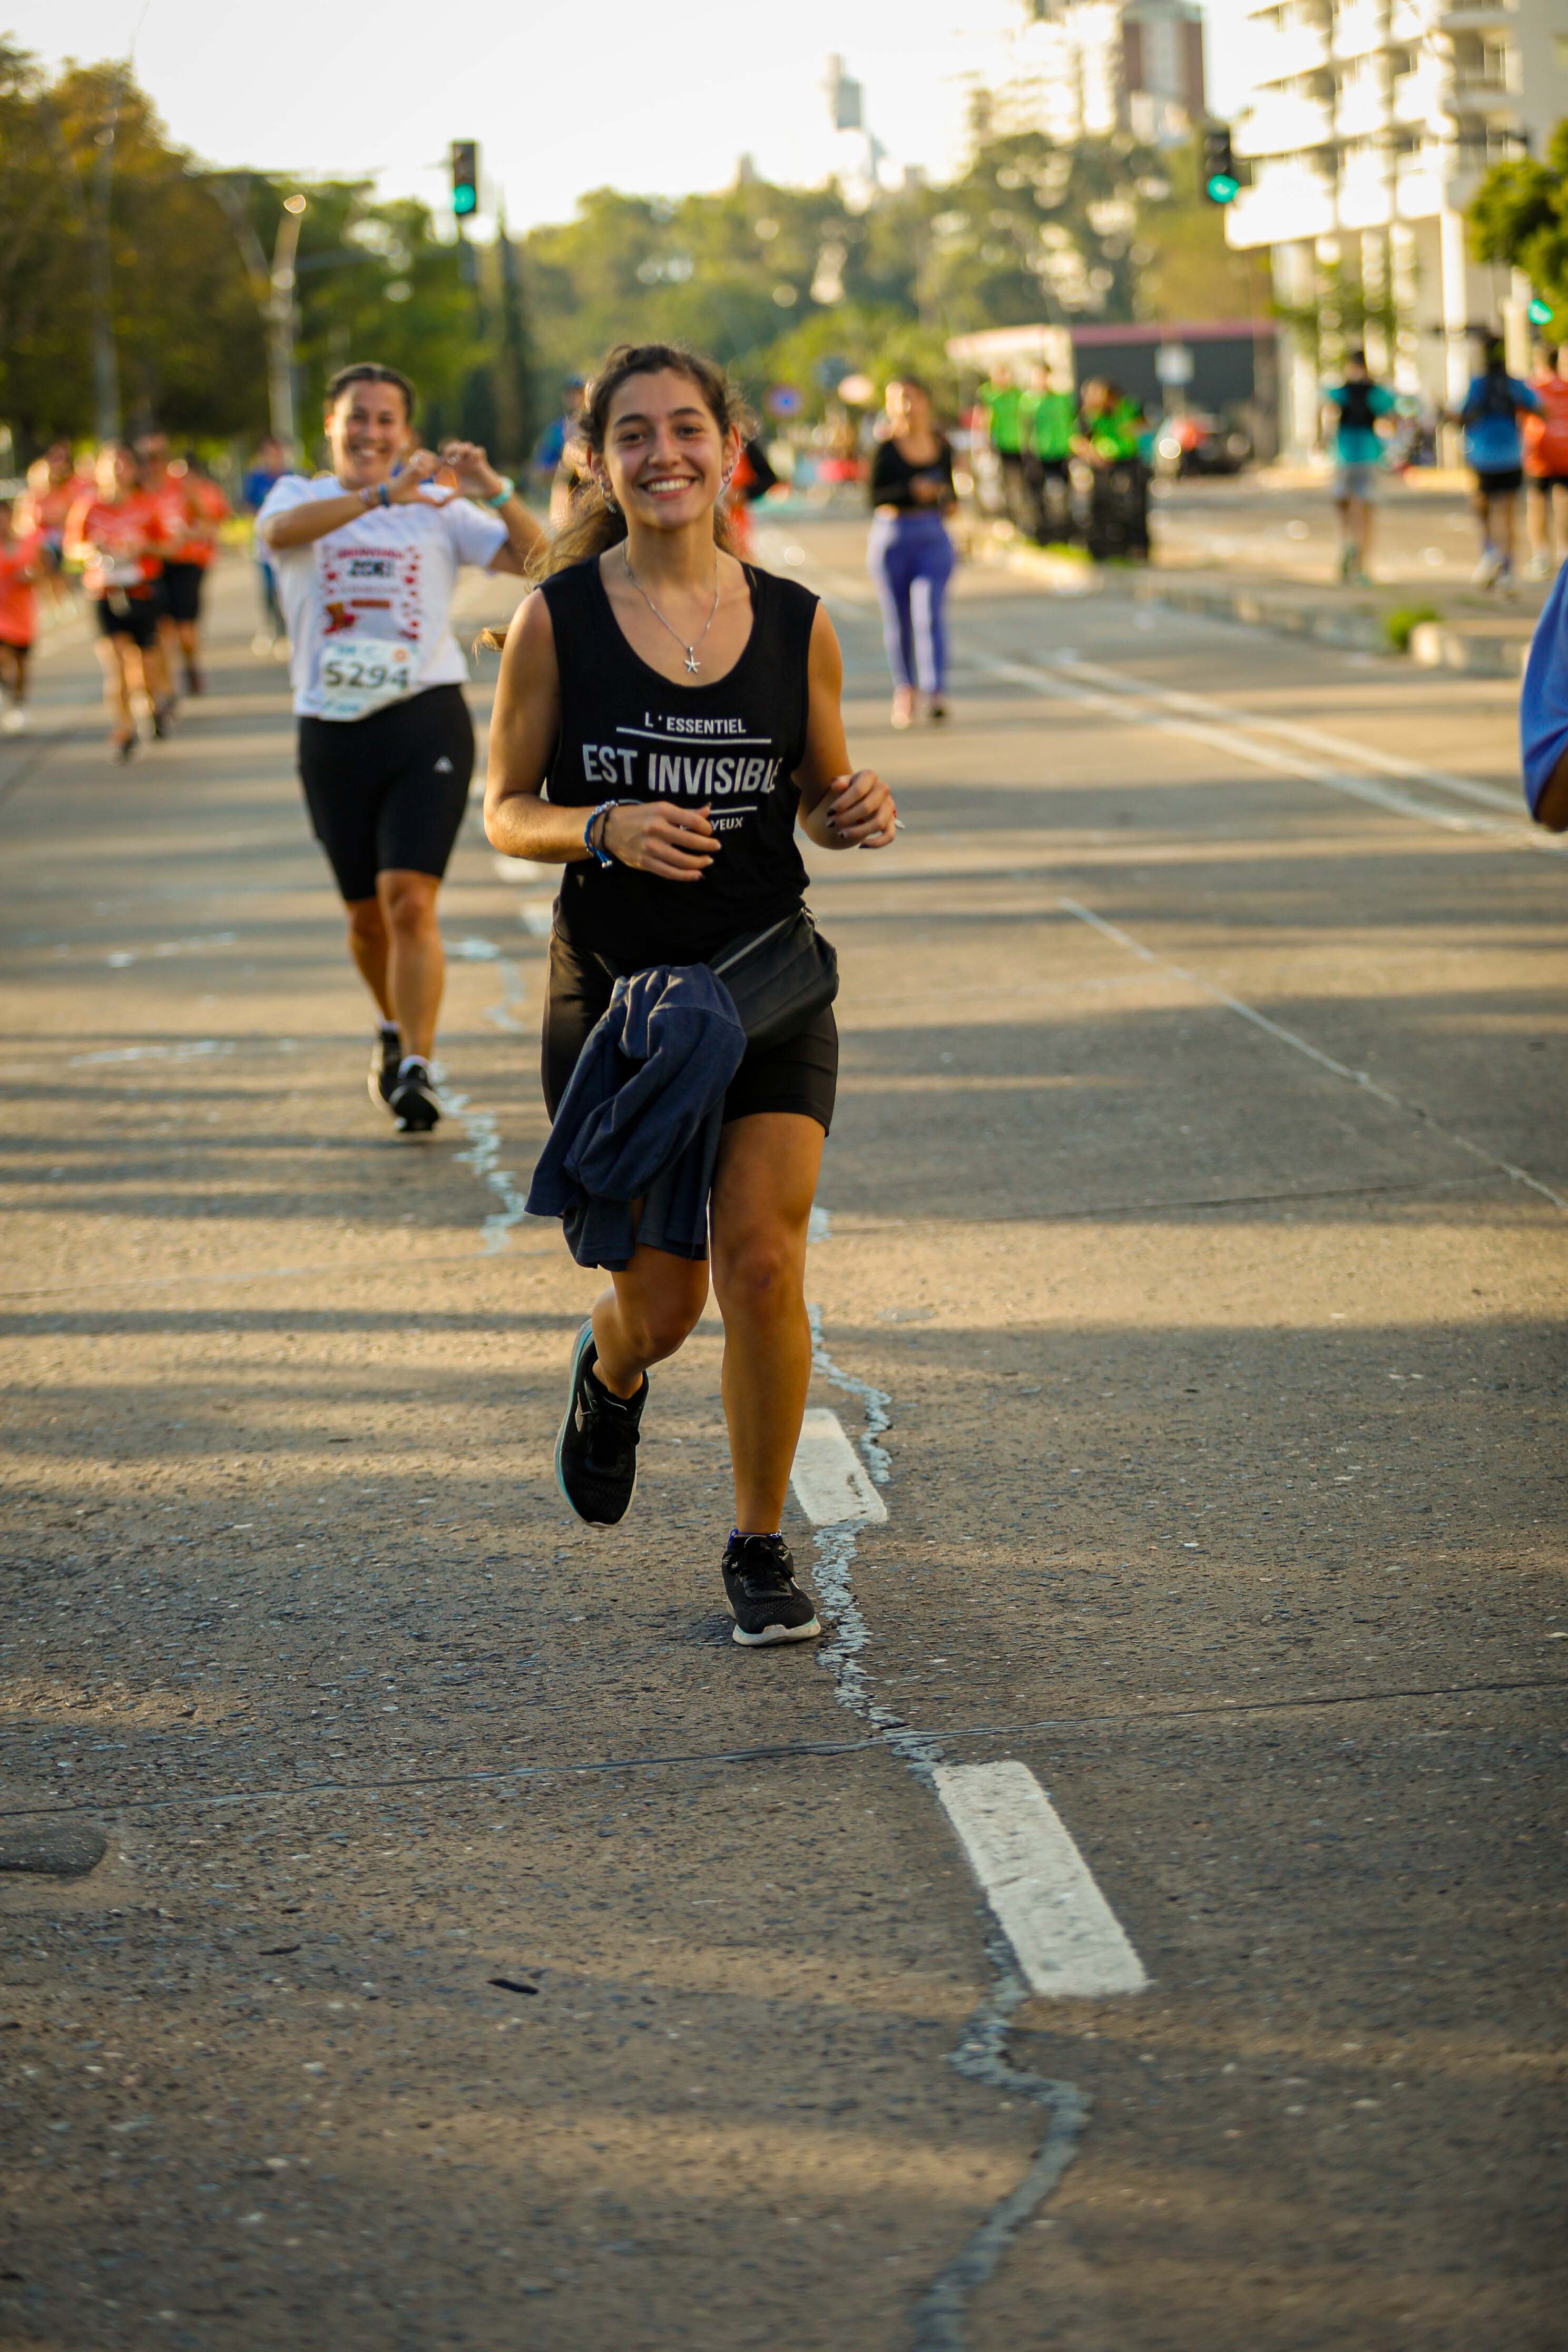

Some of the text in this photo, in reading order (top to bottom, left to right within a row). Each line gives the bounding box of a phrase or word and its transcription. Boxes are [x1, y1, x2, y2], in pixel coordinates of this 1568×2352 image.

[325, 661, 409, 688] 5294
[583, 744, 638, 785] EST
[711, 817, 743, 831] YEUX
